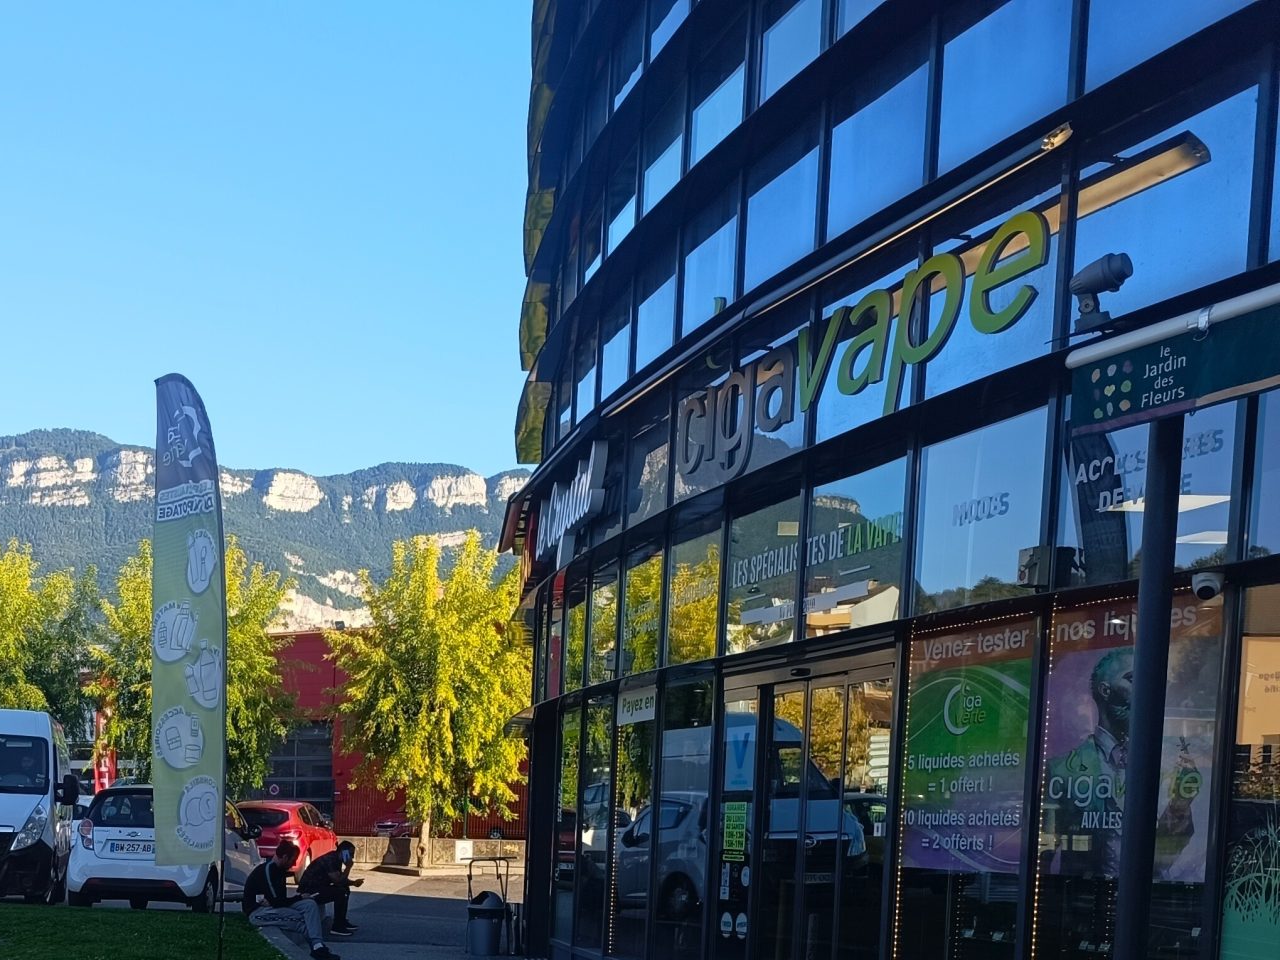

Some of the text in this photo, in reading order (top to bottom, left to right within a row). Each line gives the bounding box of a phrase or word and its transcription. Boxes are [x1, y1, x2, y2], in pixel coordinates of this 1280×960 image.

[677, 210, 1051, 479] cigavape
[1160, 345, 1170, 358] le
[1143, 355, 1187, 379] Jardin
[1154, 374, 1174, 390] des
[1140, 385, 1185, 408] Fleurs
[732, 560, 748, 589] LES
[828, 528, 845, 560] DE
[847, 522, 862, 555] LA
[1056, 619, 1096, 642] nos
[923, 628, 1030, 660] Venez tester
[621, 695, 655, 716] Payez en
[908, 748, 1020, 773] 5 liquides achetés
[940, 777, 945, 793] 1
[950, 776, 984, 793] offert
[918, 810, 965, 829] liquides
[968, 809, 1020, 827] achetés
[1081, 811, 1122, 829] AIX LES
[932, 834, 940, 849] 2
[944, 833, 984, 850] offerts
